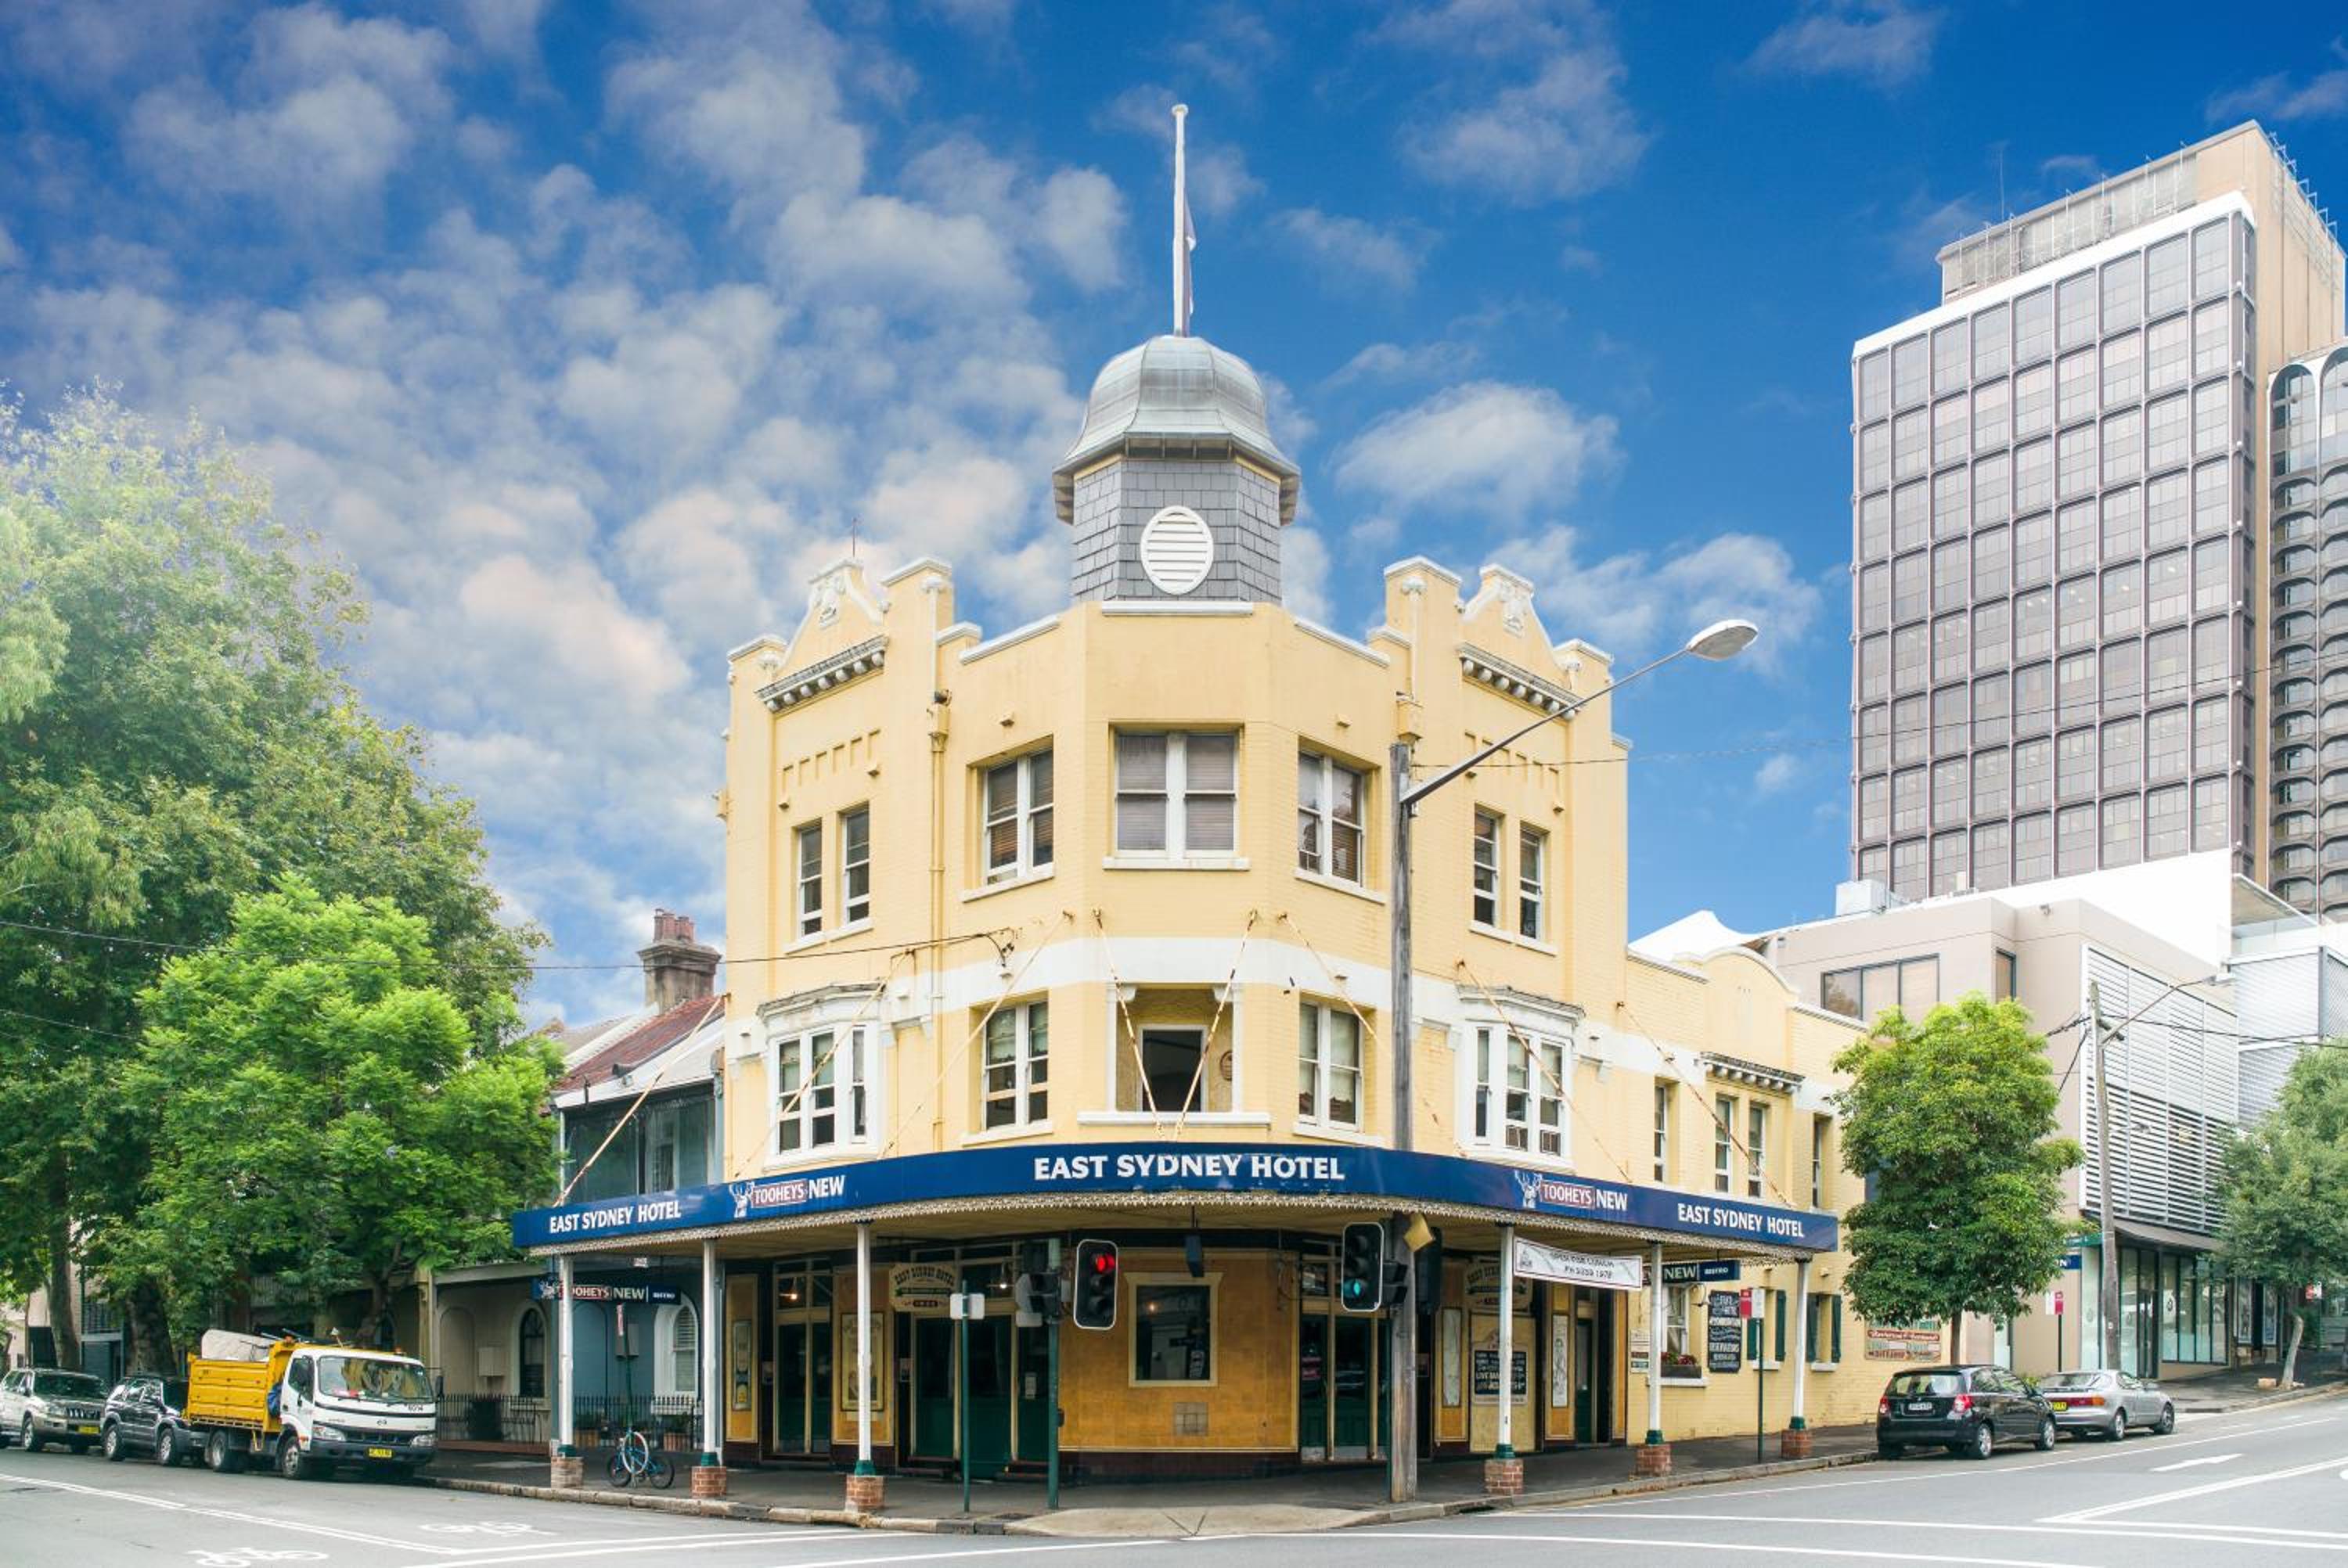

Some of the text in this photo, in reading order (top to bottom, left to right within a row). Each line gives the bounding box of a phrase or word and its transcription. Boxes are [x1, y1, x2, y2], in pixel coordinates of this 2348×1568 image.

[1034, 1154, 1345, 1181] EAST SYDNEY HOTEL
[754, 1174, 845, 1204] TOOHEYS NEW
[1542, 1184, 1628, 1211] TOOHEYS NEW
[549, 1200, 682, 1234] EAST SYDNEY HOTEL
[1677, 1203, 1804, 1238] EAST SYDNEY HOTEL
[1664, 1265, 1697, 1279] NEW
[614, 1286, 644, 1300] NEW
